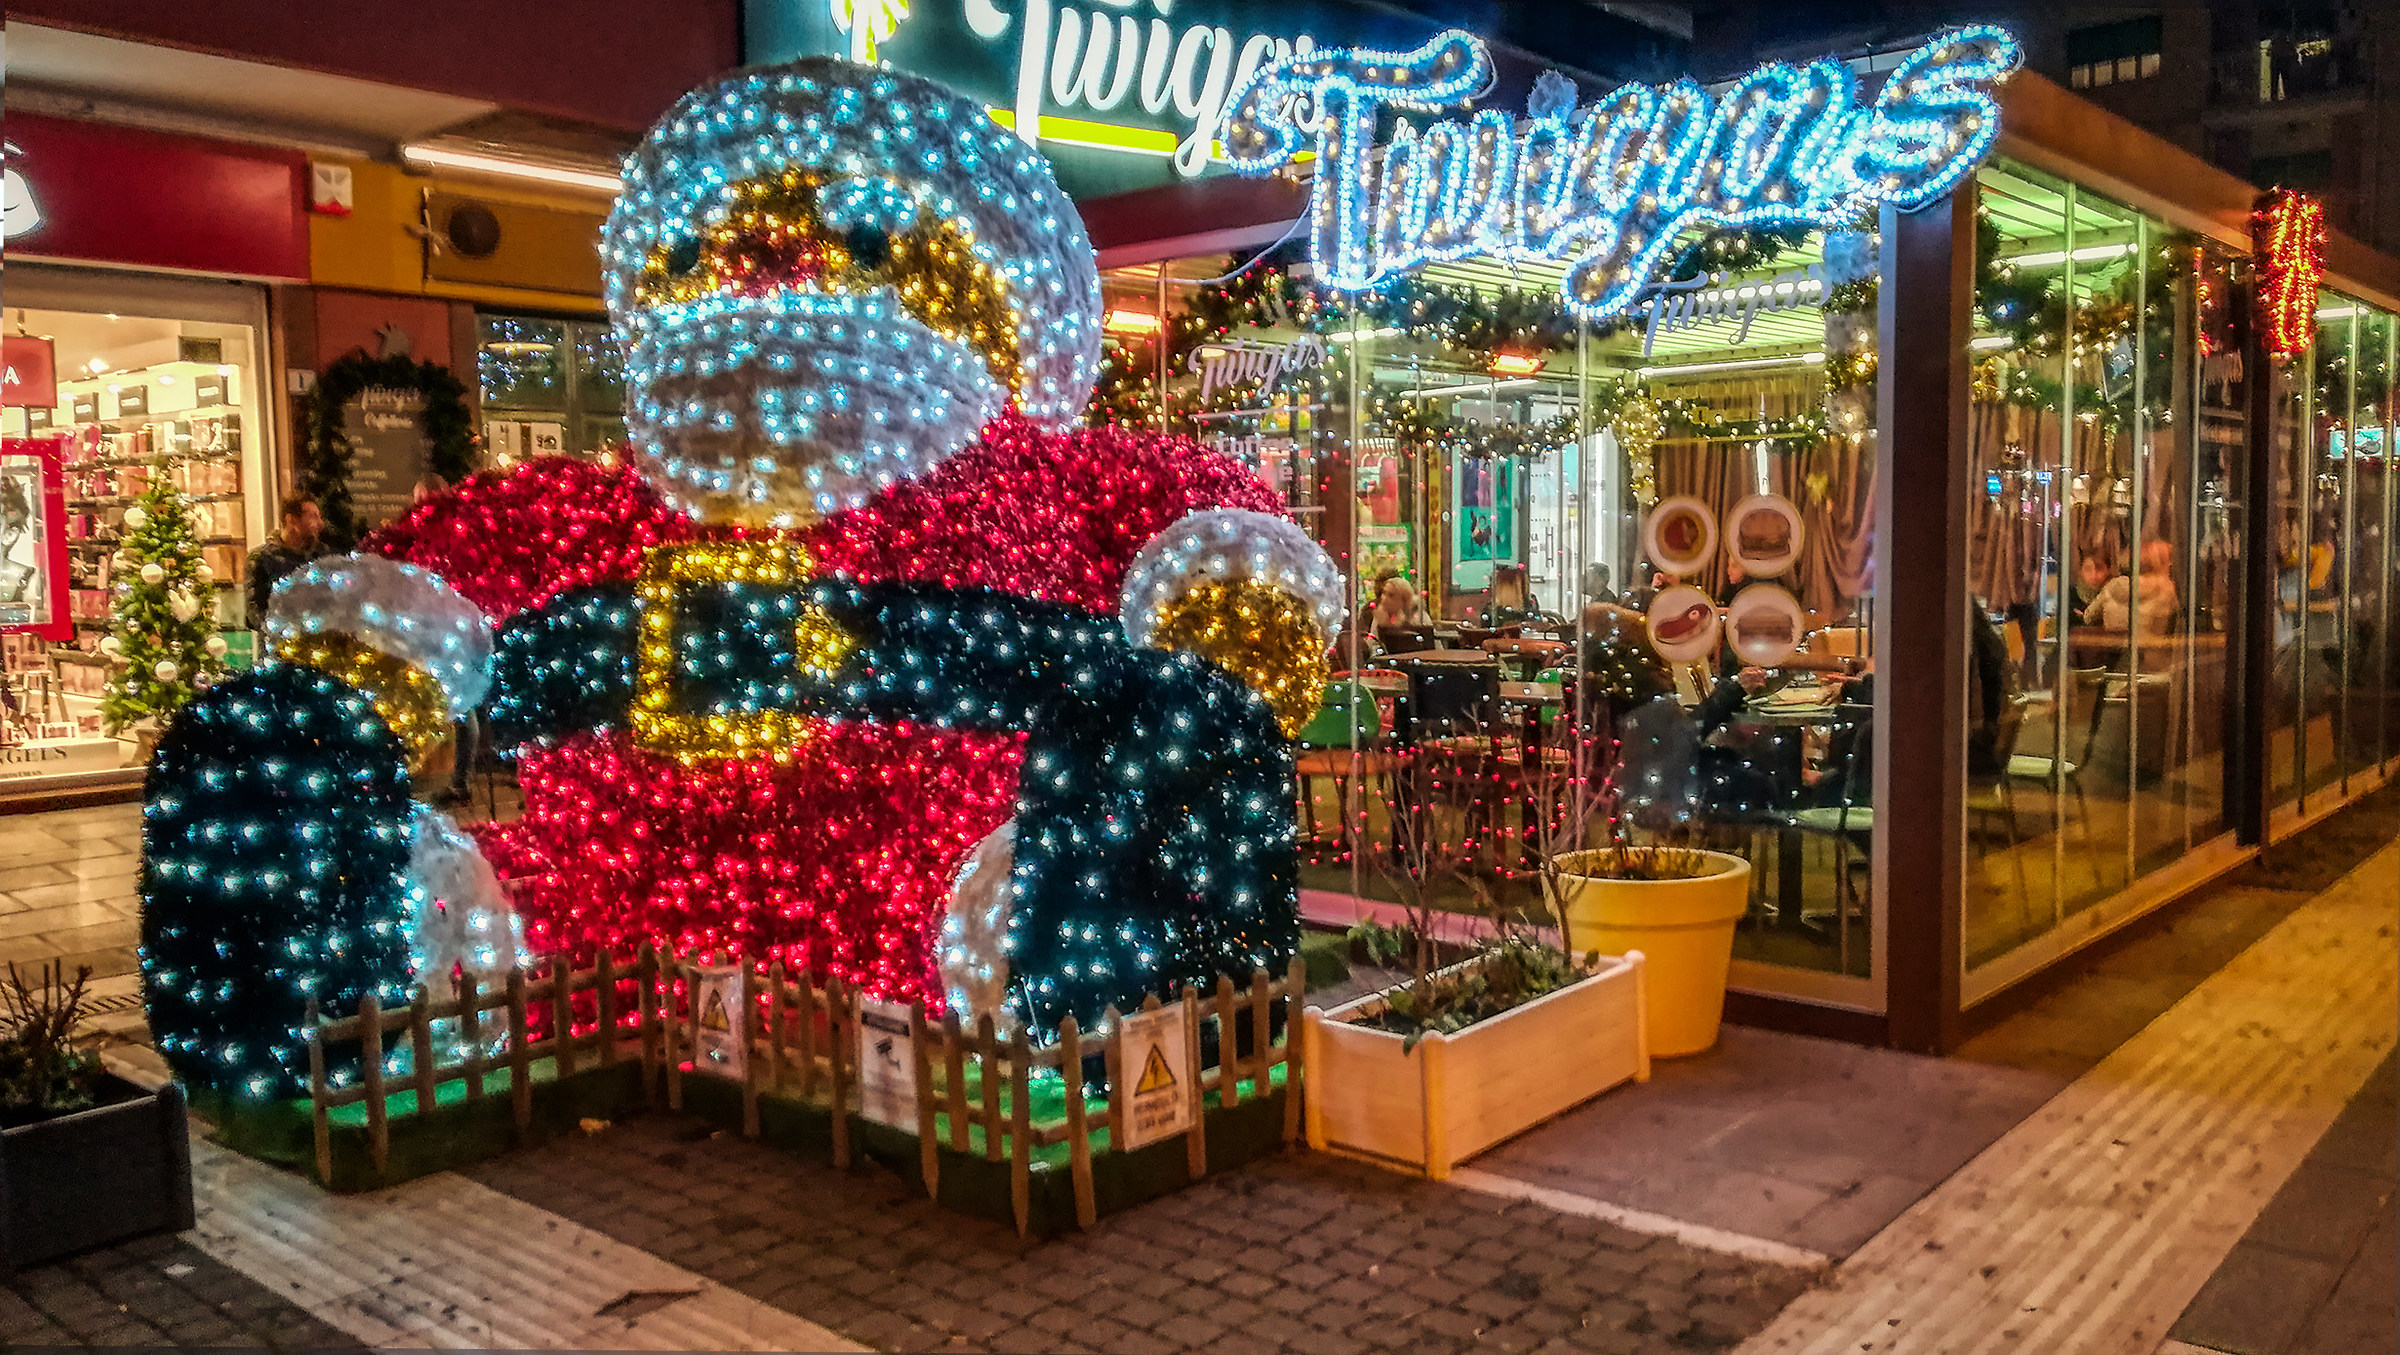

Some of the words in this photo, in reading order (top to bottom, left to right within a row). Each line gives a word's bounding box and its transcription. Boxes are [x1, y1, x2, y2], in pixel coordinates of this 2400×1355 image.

[1222, 25, 2020, 317] Twigas
[1632, 263, 1833, 357] Twigas
[1188, 334, 1325, 406] Twigas
